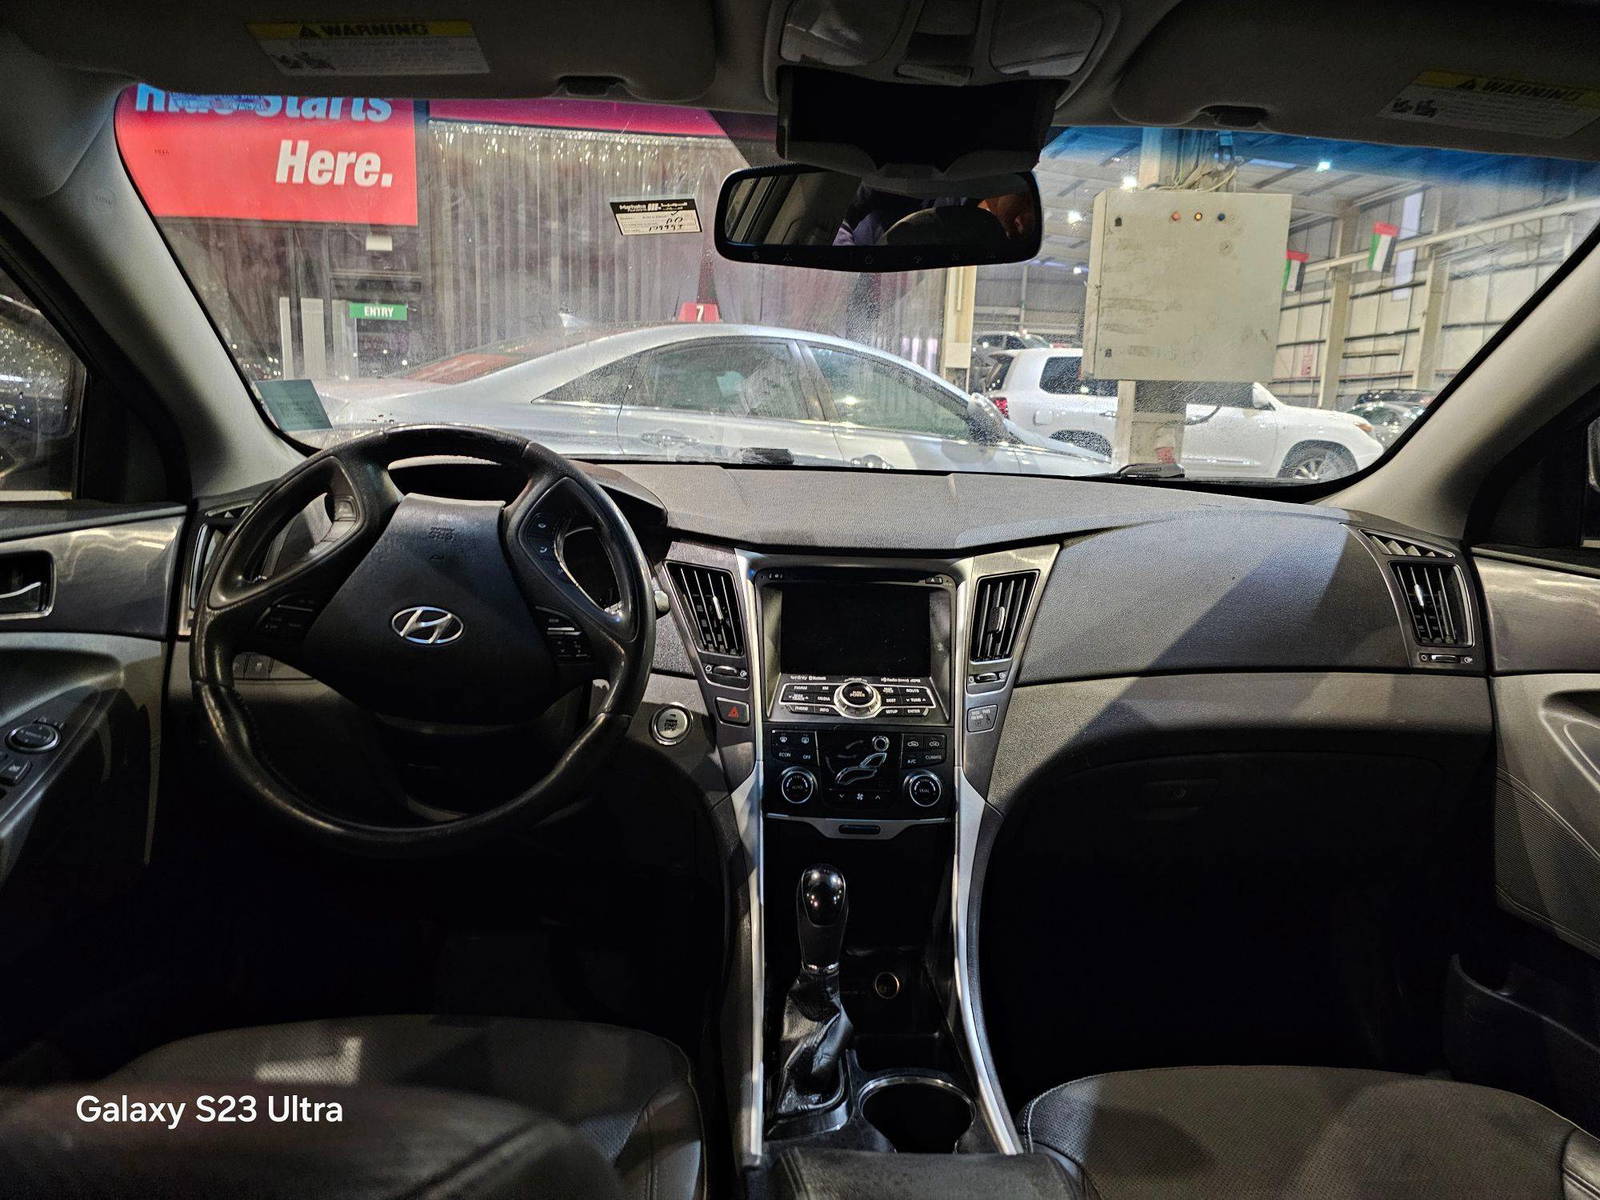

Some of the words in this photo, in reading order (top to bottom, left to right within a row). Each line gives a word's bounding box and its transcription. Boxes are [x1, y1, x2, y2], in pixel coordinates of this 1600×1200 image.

[321, 23, 429, 36] WARNING
[1483, 79, 1584, 101] WARNING
[276, 140, 392, 187] Here.
[364, 305, 394, 318] ENTRY
[696, 304, 704, 322] 7
